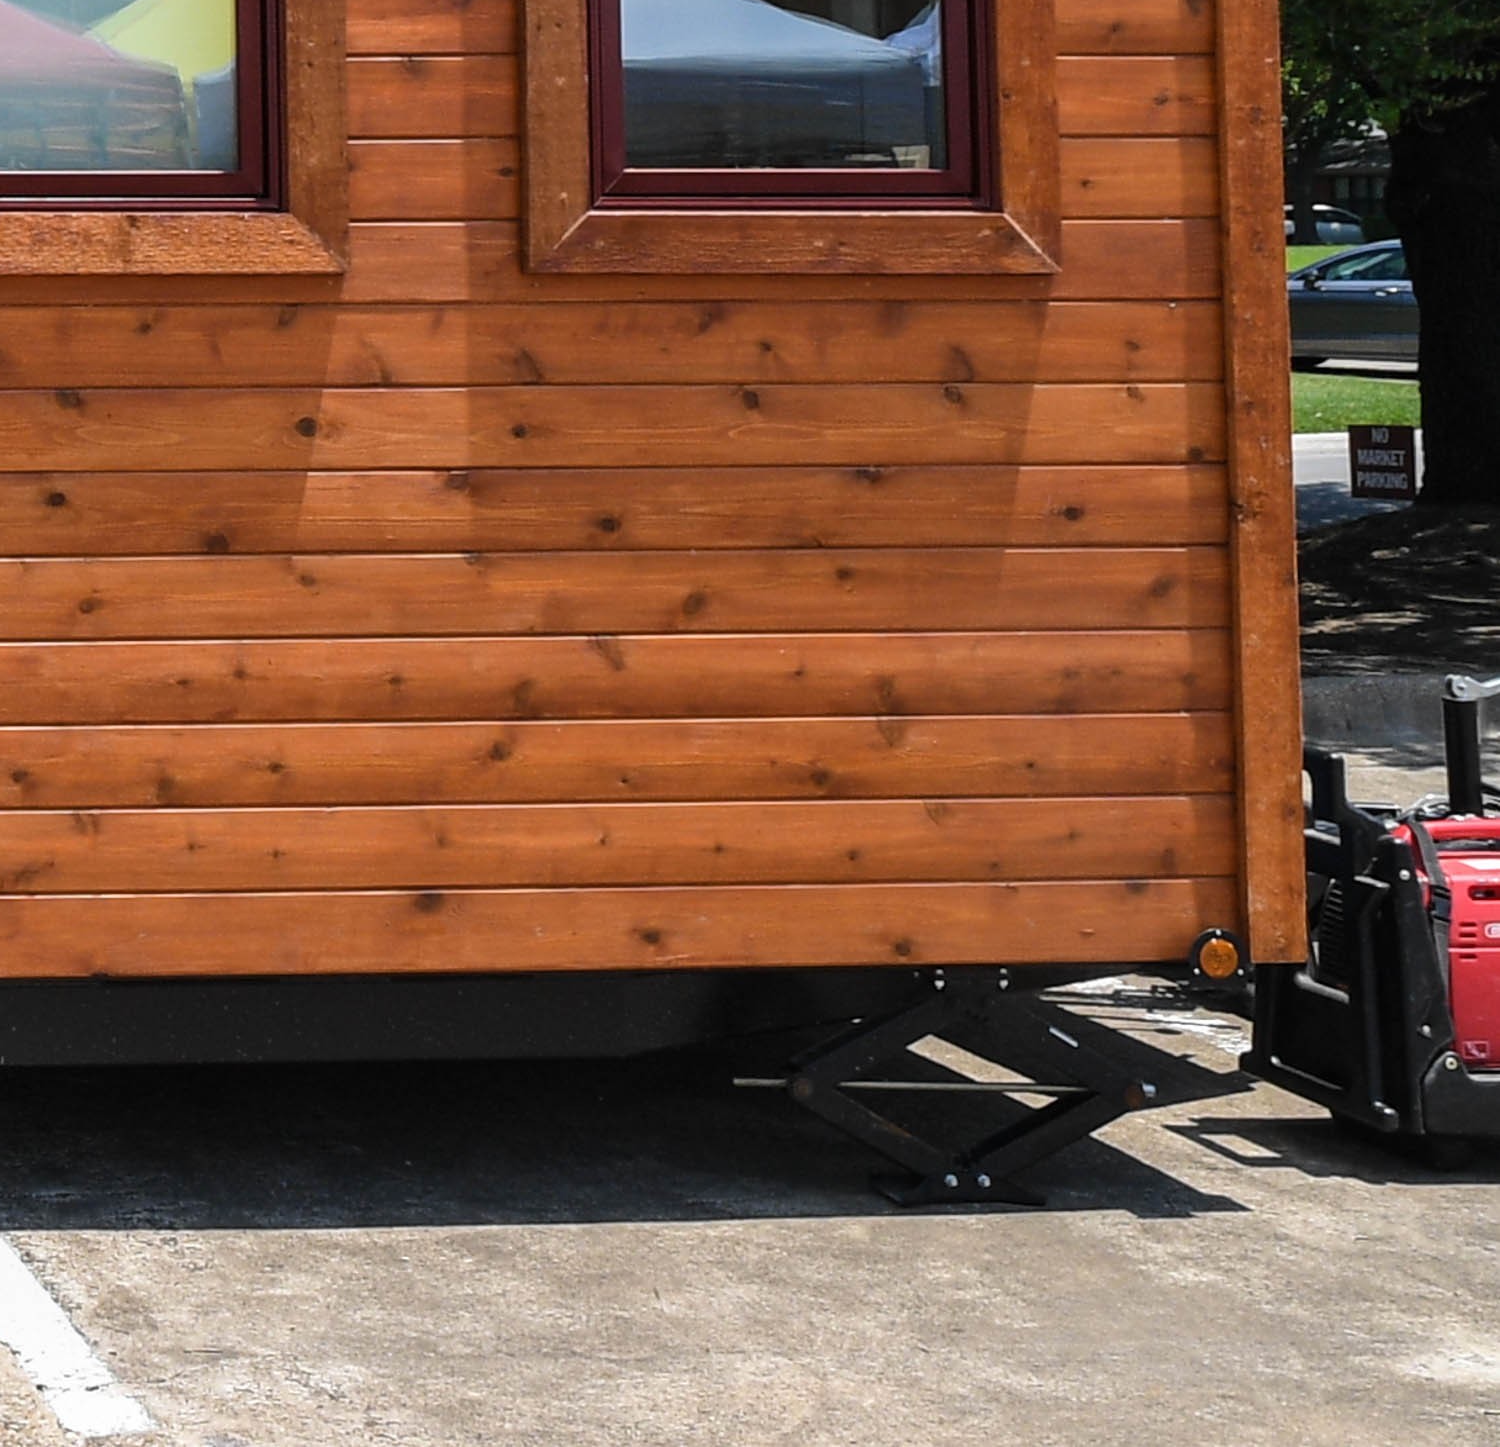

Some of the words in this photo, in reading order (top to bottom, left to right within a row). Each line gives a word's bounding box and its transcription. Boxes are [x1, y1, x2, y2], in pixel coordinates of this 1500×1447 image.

[1371, 427, 1389, 443] NO
[1357, 449, 1406, 466] MARKET
[1356, 472, 1408, 489] PARKING
